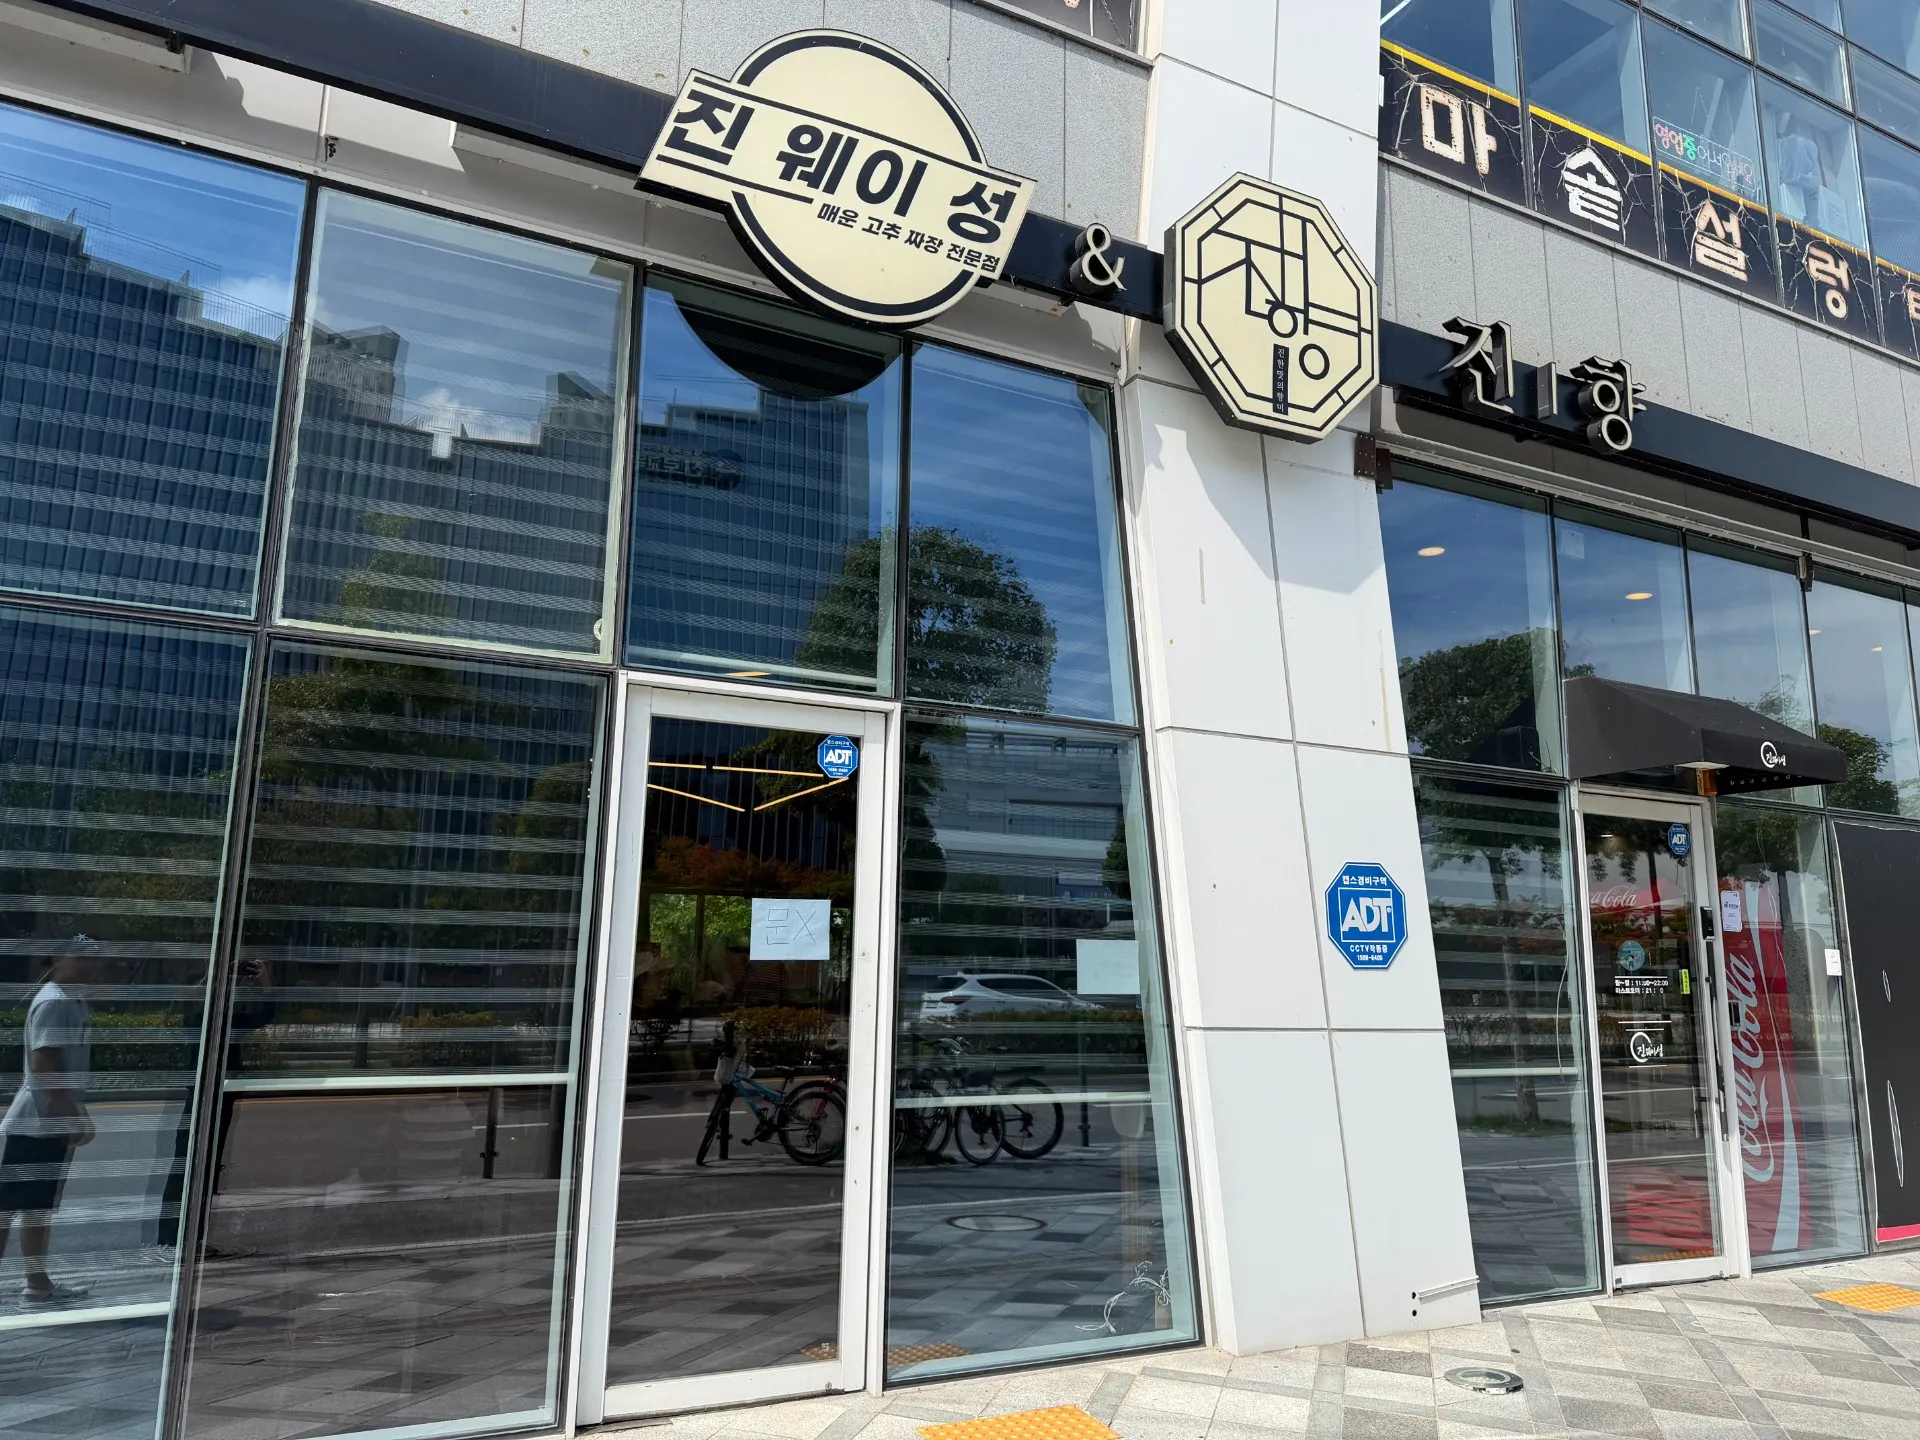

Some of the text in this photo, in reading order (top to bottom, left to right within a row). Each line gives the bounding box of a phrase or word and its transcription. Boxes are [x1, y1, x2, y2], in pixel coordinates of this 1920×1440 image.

[817, 202, 1001, 274] 매운 고추 짜장 전문점
[1078, 222, 1127, 291] &
[825, 748, 852, 765] ADT
[1672, 833, 1687, 846] ADT
[1342, 875, 1387, 886] 캡스경비구역
[1341, 896, 1391, 933] ADT
[1350, 944, 1388, 954] CCTV작동중
